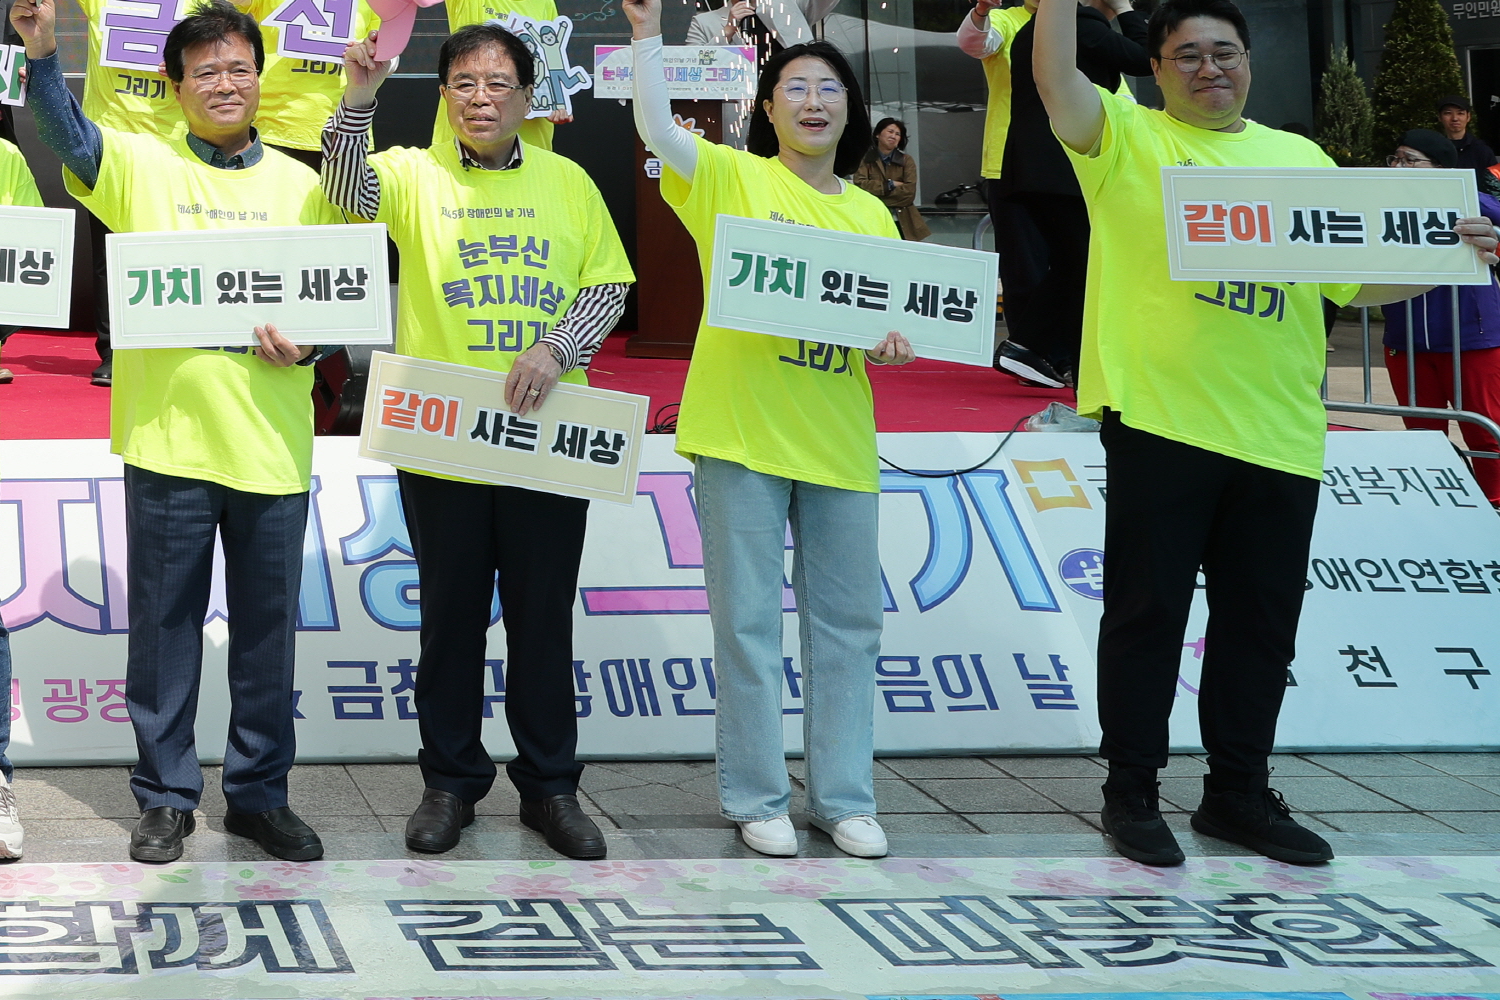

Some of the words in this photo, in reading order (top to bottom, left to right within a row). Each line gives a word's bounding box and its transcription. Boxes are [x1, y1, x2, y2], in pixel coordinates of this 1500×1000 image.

[114, 73, 167, 100] 그리기
[602, 66, 633, 82] 눈부
[663, 66, 703, 82] 지세상
[238, 211, 247, 221] 날
[251, 211, 268, 221] 기념
[467, 207, 503, 219] 장애인의
[505, 208, 514, 218] 날
[517, 208, 536, 219] 기념
[1184, 204, 1272, 243] 같이
[1288, 210, 1364, 245] 사는
[1381, 211, 1461, 246] 세상
[457, 234, 551, 269] 눈부신
[126, 267, 202, 308] 가치
[215, 270, 283, 305] 있는
[298, 266, 369, 303] 세상
[441, 274, 566, 317] 복지세상
[728, 251, 808, 300] 가치
[820, 269, 890, 313] 있는
[903, 281, 979, 324] 세상
[381, 389, 460, 438] 같이
[469, 410, 538, 452] 사는
[550, 424, 626, 467] 세상
[1323, 466, 1478, 508] 합복지관
[1303, 557, 1500, 595] 애인연합
[1012, 653, 1080, 710] 날
[384, 899, 822, 973] 걷는
[818, 894, 1497, 969] 따뜻한
